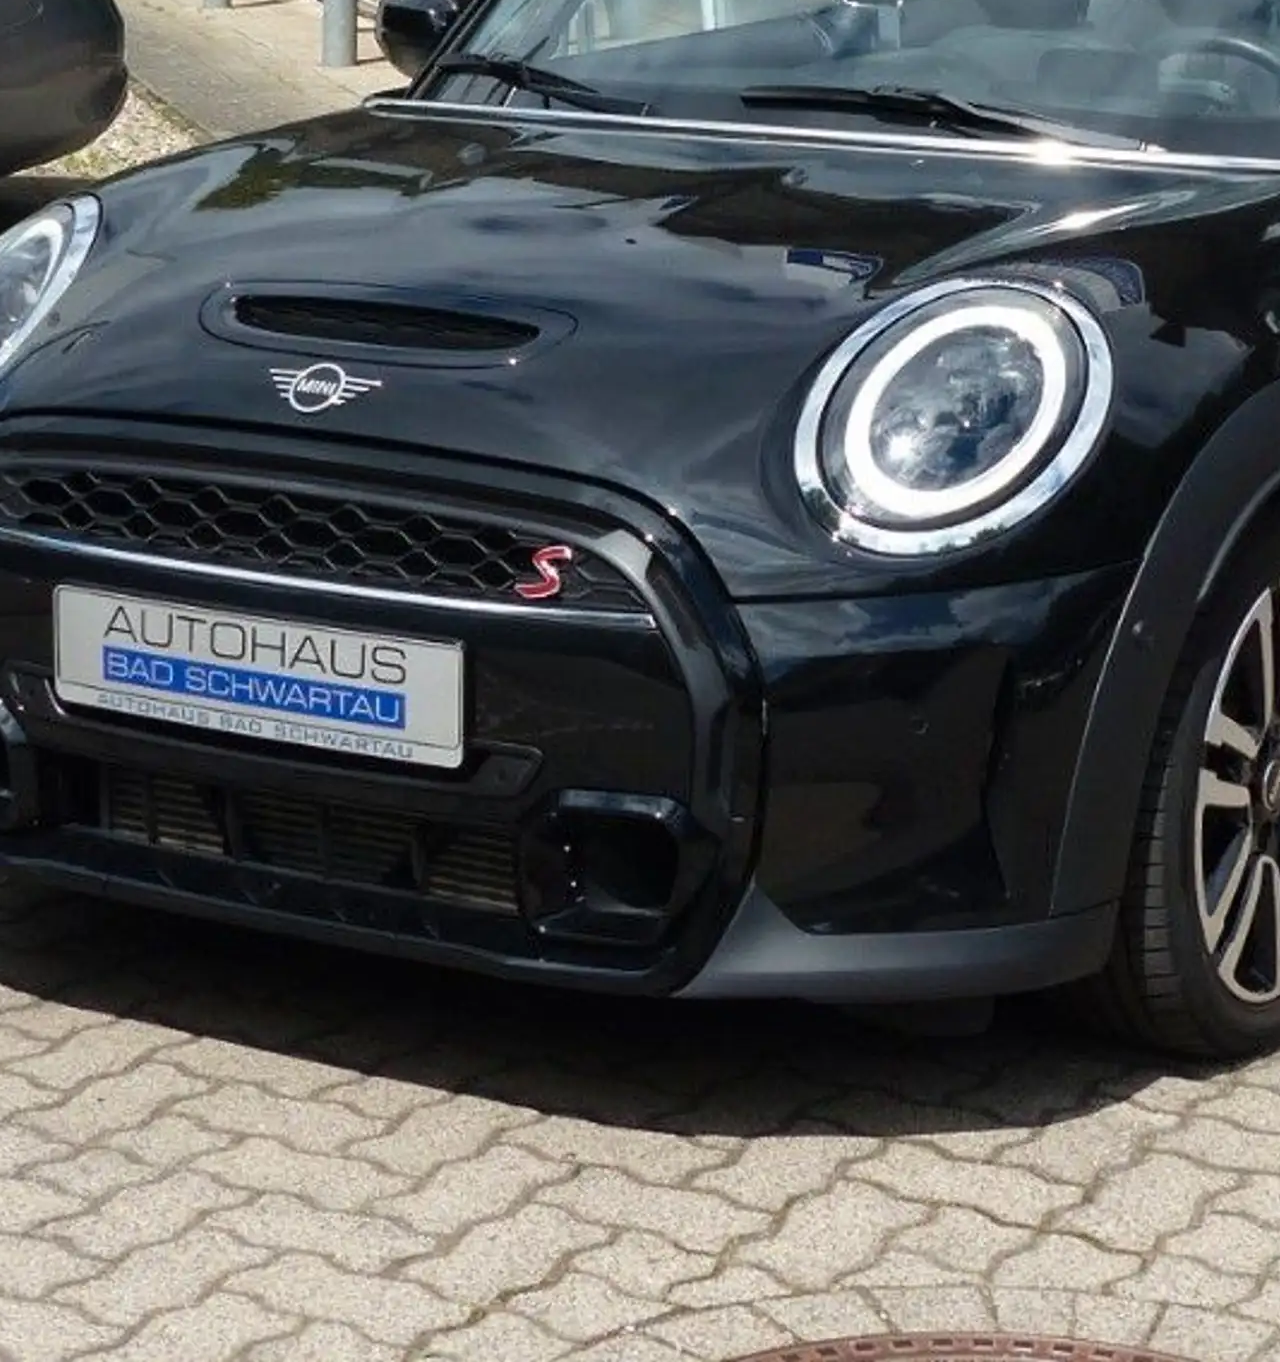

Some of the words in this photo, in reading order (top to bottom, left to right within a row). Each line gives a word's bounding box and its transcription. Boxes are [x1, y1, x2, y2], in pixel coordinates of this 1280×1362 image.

[514, 545, 572, 599] S
[104, 605, 407, 685] AUTOHAUS
[107, 651, 174, 686] BAD
[185, 665, 401, 724] SCHWARTAU
[97, 693, 210, 723] AUTOHAUS
[220, 715, 263, 735] BAD
[275, 724, 414, 759] SCHWARTAU
